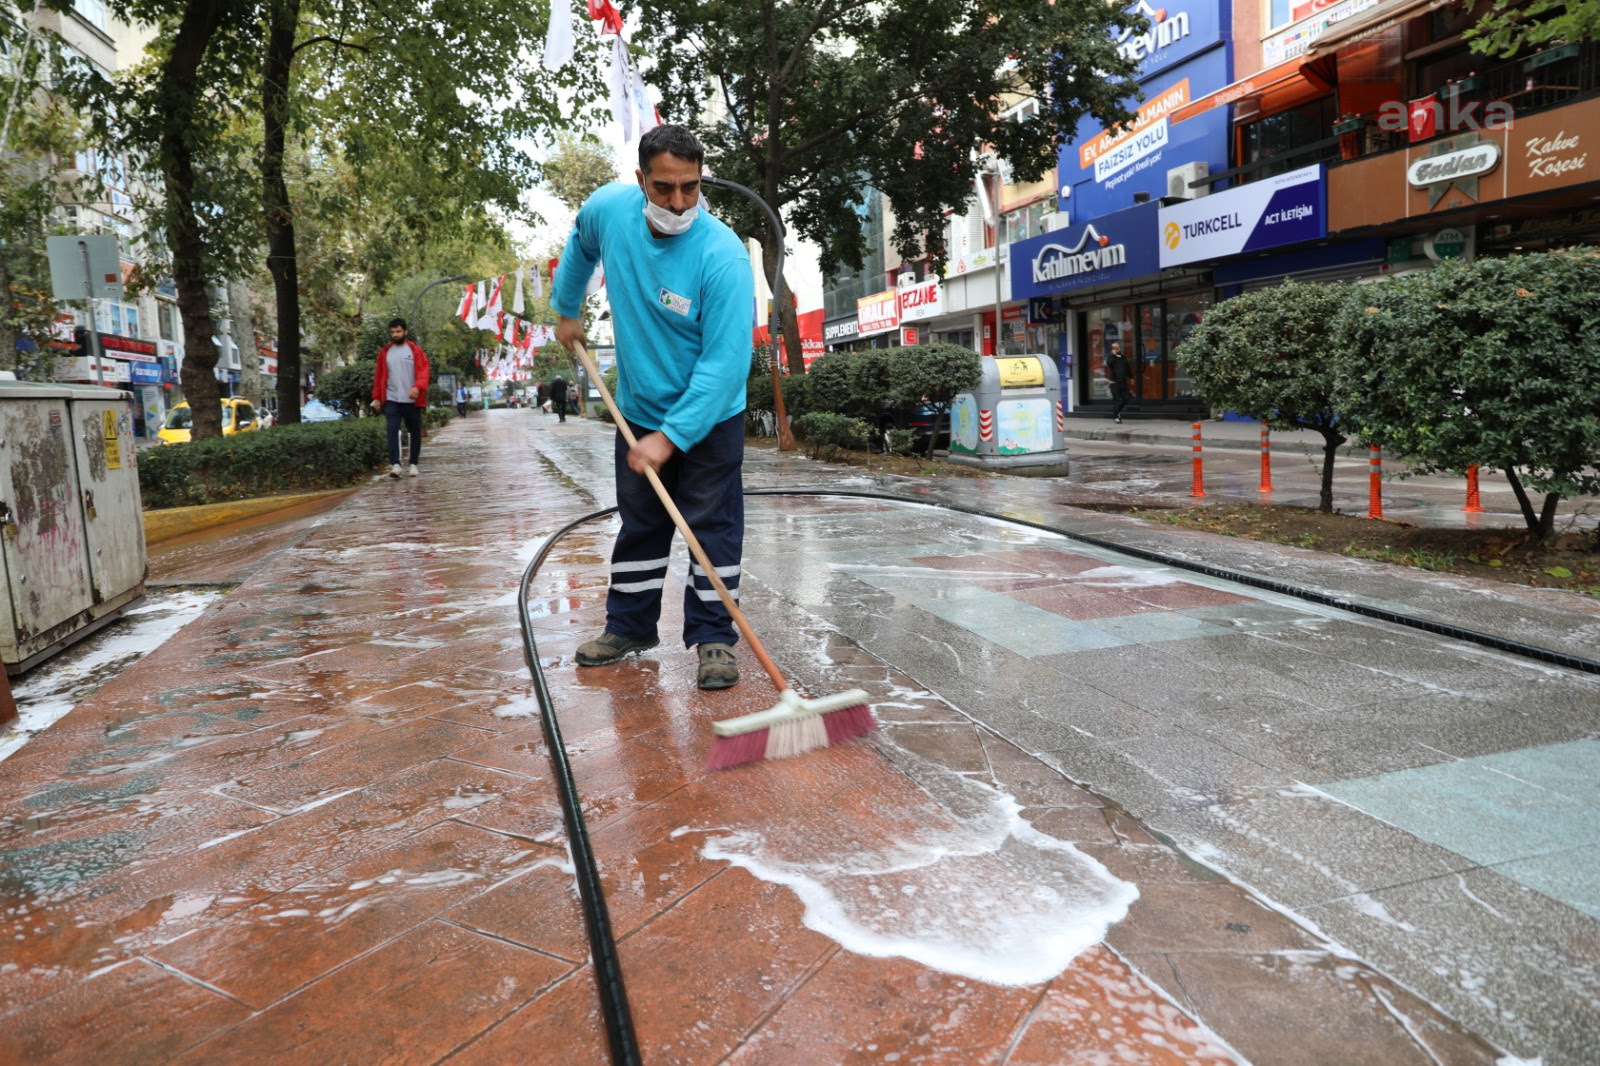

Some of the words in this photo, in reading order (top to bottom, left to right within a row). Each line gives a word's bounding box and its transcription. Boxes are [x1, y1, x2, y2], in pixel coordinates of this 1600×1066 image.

[1133, 87, 1184, 130] ALMANIN
[1098, 144, 1134, 175] FAİZSİZ
[1135, 125, 1165, 152] YOLU
[1525, 131, 1580, 157] Kahve
[1528, 153, 1588, 178] Köşesi
[1183, 212, 1242, 239] TURKCELL
[1265, 212, 1280, 226] ACT
[1281, 204, 1313, 221] İLETİŞİM
[1439, 233, 1459, 241] ATM
[902, 284, 937, 309] ECZANE
[905, 330, 915, 344] E
